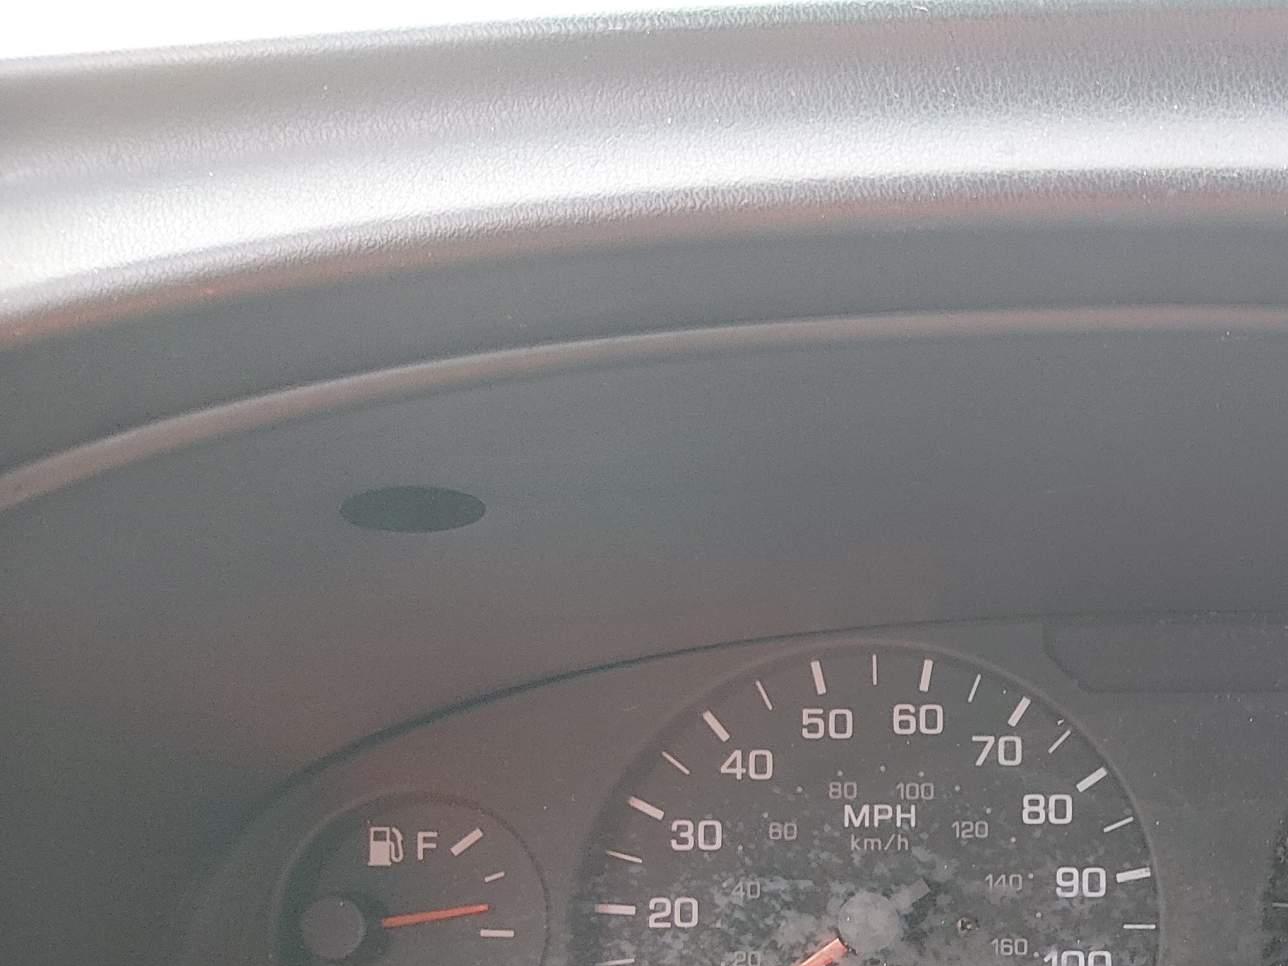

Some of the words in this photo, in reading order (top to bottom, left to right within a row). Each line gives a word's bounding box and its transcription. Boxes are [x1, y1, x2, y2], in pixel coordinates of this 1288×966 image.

[801, 708, 854, 740] 50
[892, 703, 944, 735] 60
[971, 735, 1022, 766] 70
[720, 749, 774, 780] 40
[828, 783, 857, 800] 80
[896, 782, 935, 801] 100
[843, 805, 916, 828] MPH
[1021, 794, 1073, 824] 80
[670, 820, 722, 850] 30
[768, 823, 797, 841] 60
[850, 832, 909, 851] km/h
[951, 821, 989, 839] 120
[417, 832, 438, 860] F
[731, 880, 761, 899] 40
[984, 873, 1023, 891] 140
[1055, 867, 1106, 897] 90
[648, 898, 699, 928] 20
[991, 938, 1028, 956] 160
